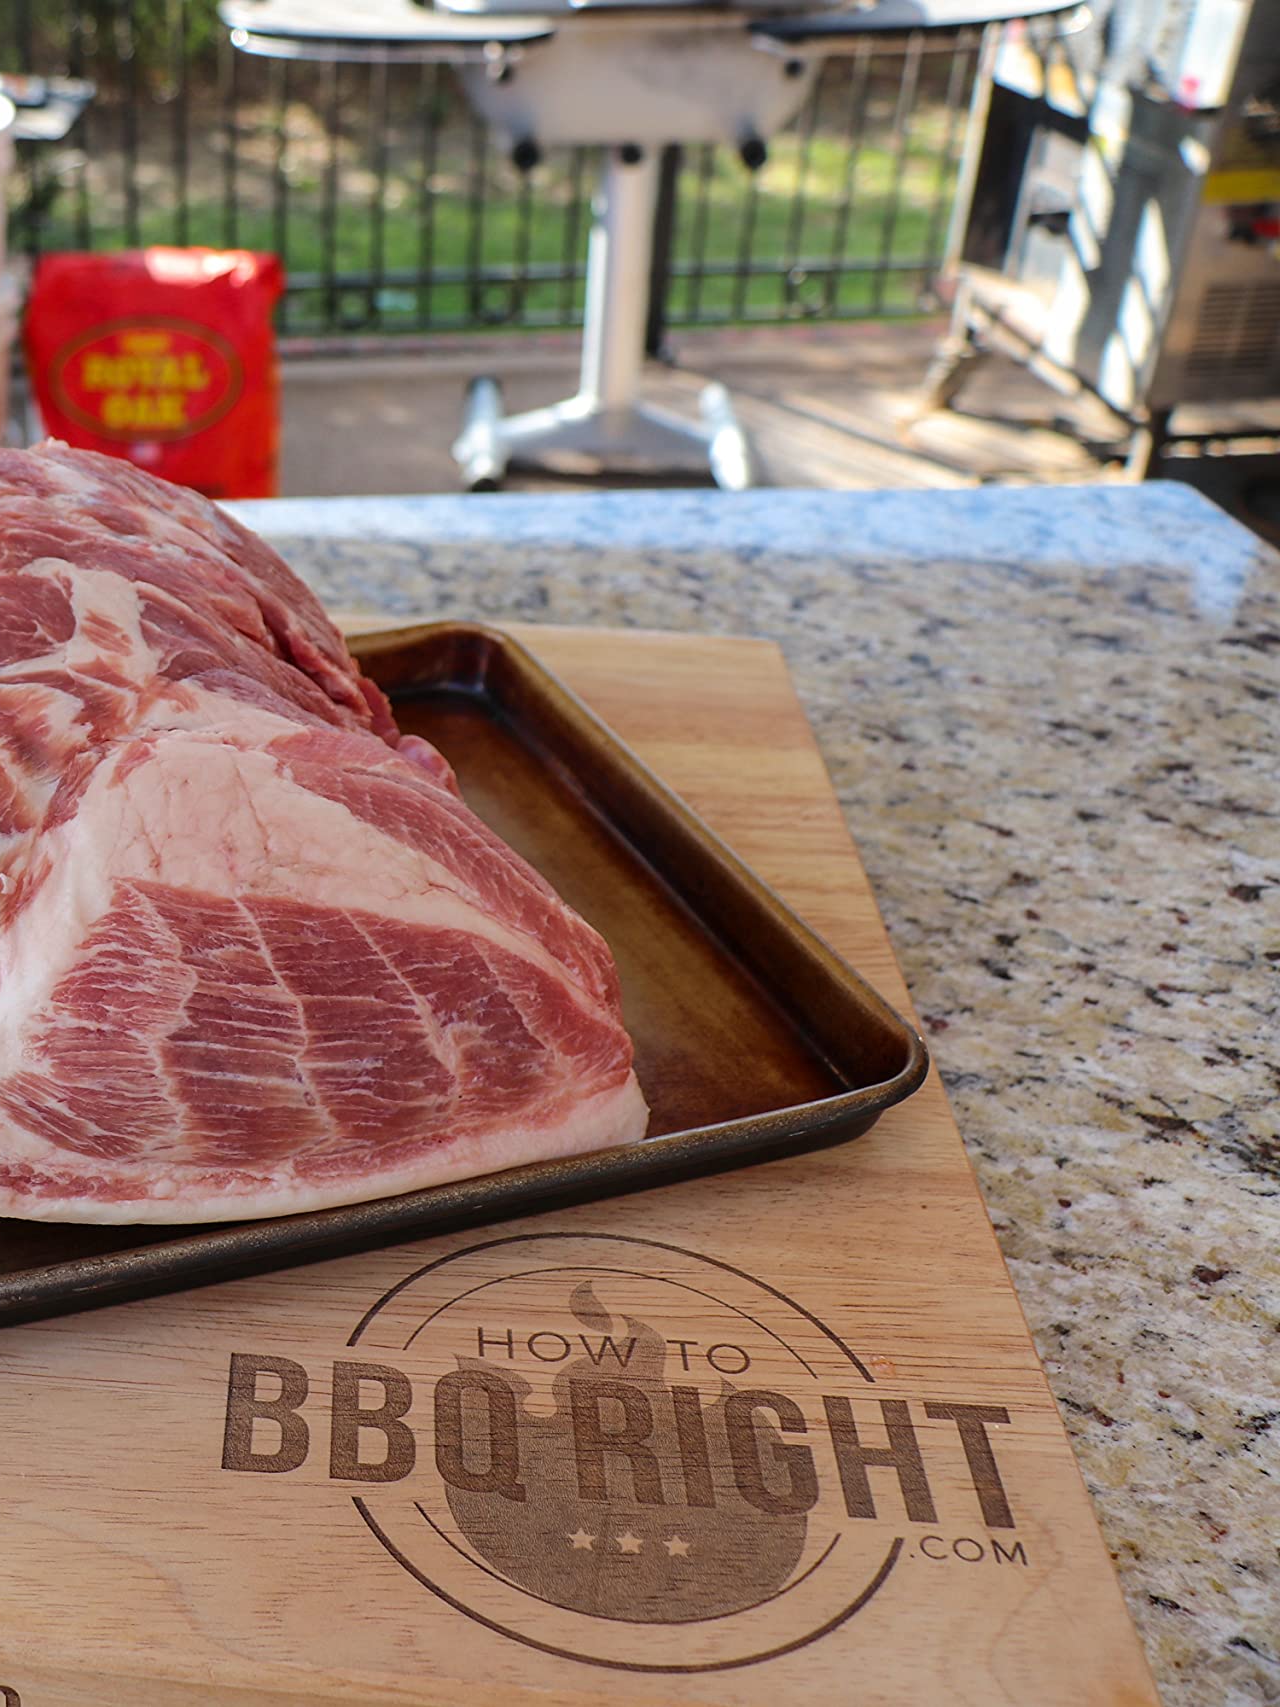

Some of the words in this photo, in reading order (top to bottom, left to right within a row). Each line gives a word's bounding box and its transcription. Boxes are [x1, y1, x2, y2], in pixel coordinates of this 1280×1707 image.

[476, 1326, 640, 1370] HOW
[665, 1339, 751, 1375] TO
[221, 1352, 527, 1503] BBQ
[568, 1376, 1017, 1530] RIGHT
[909, 1534, 1030, 1567] .COM
